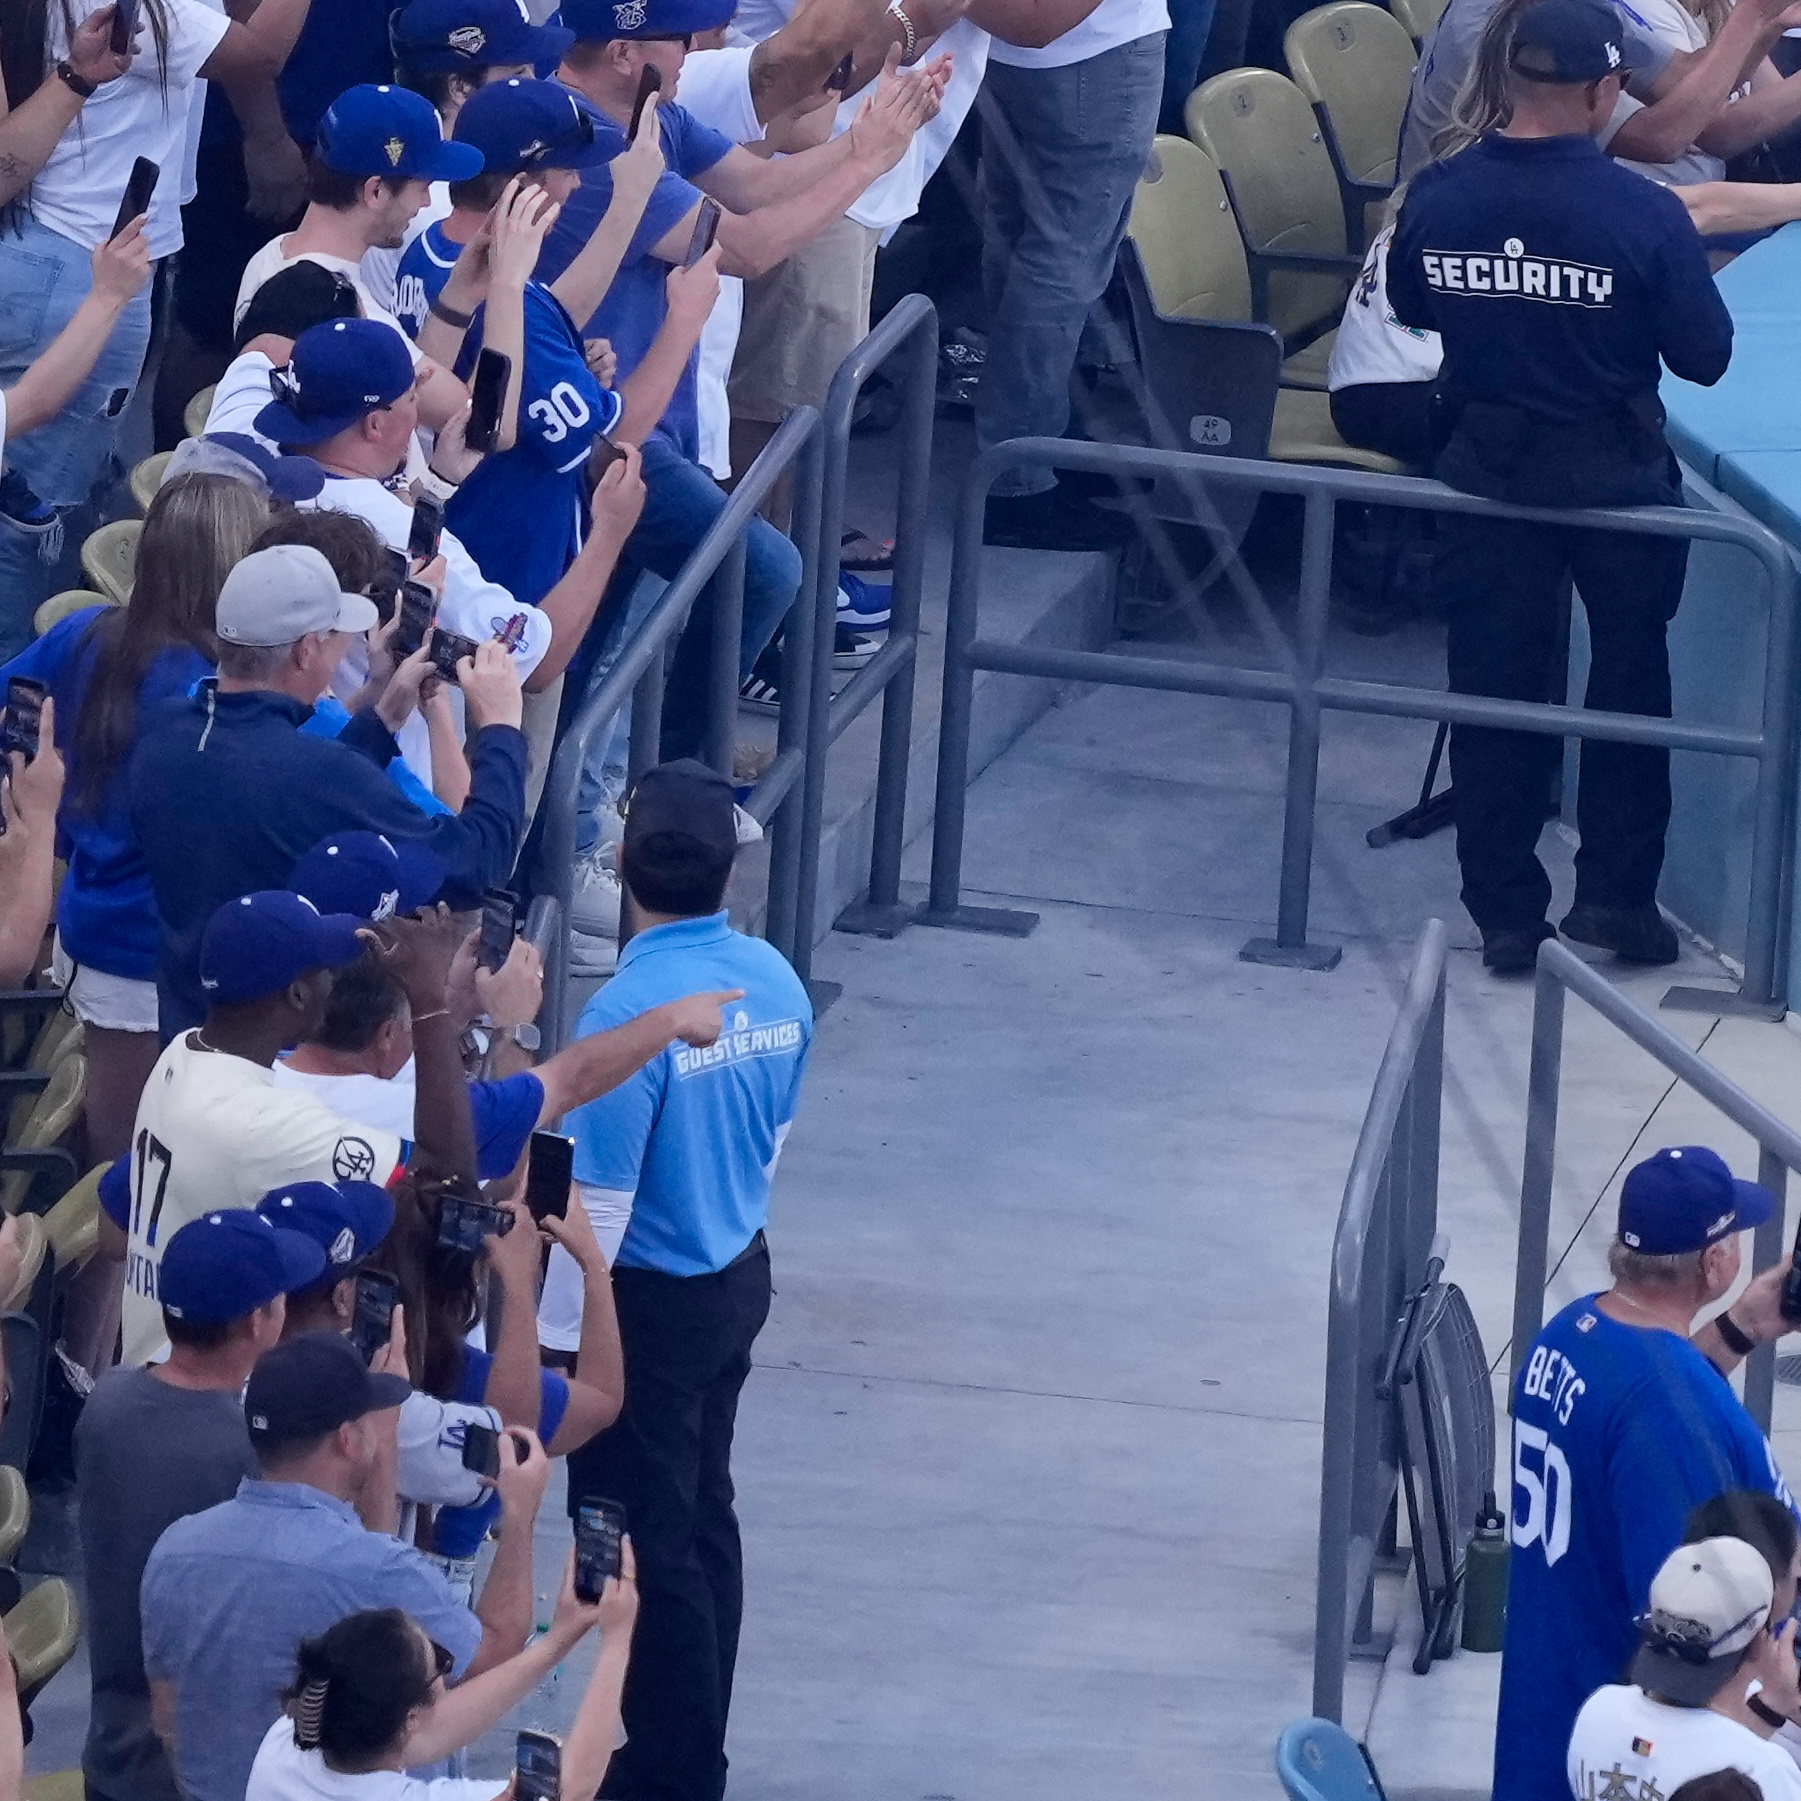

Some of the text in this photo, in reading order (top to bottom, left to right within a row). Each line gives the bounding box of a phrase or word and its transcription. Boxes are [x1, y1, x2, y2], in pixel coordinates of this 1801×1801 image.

[1604, 41, 1622, 68] LA
[1422, 253, 1613, 303] SECURITY
[528, 380, 591, 441] 30
[676, 1019, 801, 1075] GUEST SERVICES
[1524, 1345, 1586, 1428] BETTS
[1511, 1420, 1572, 1569] 50
